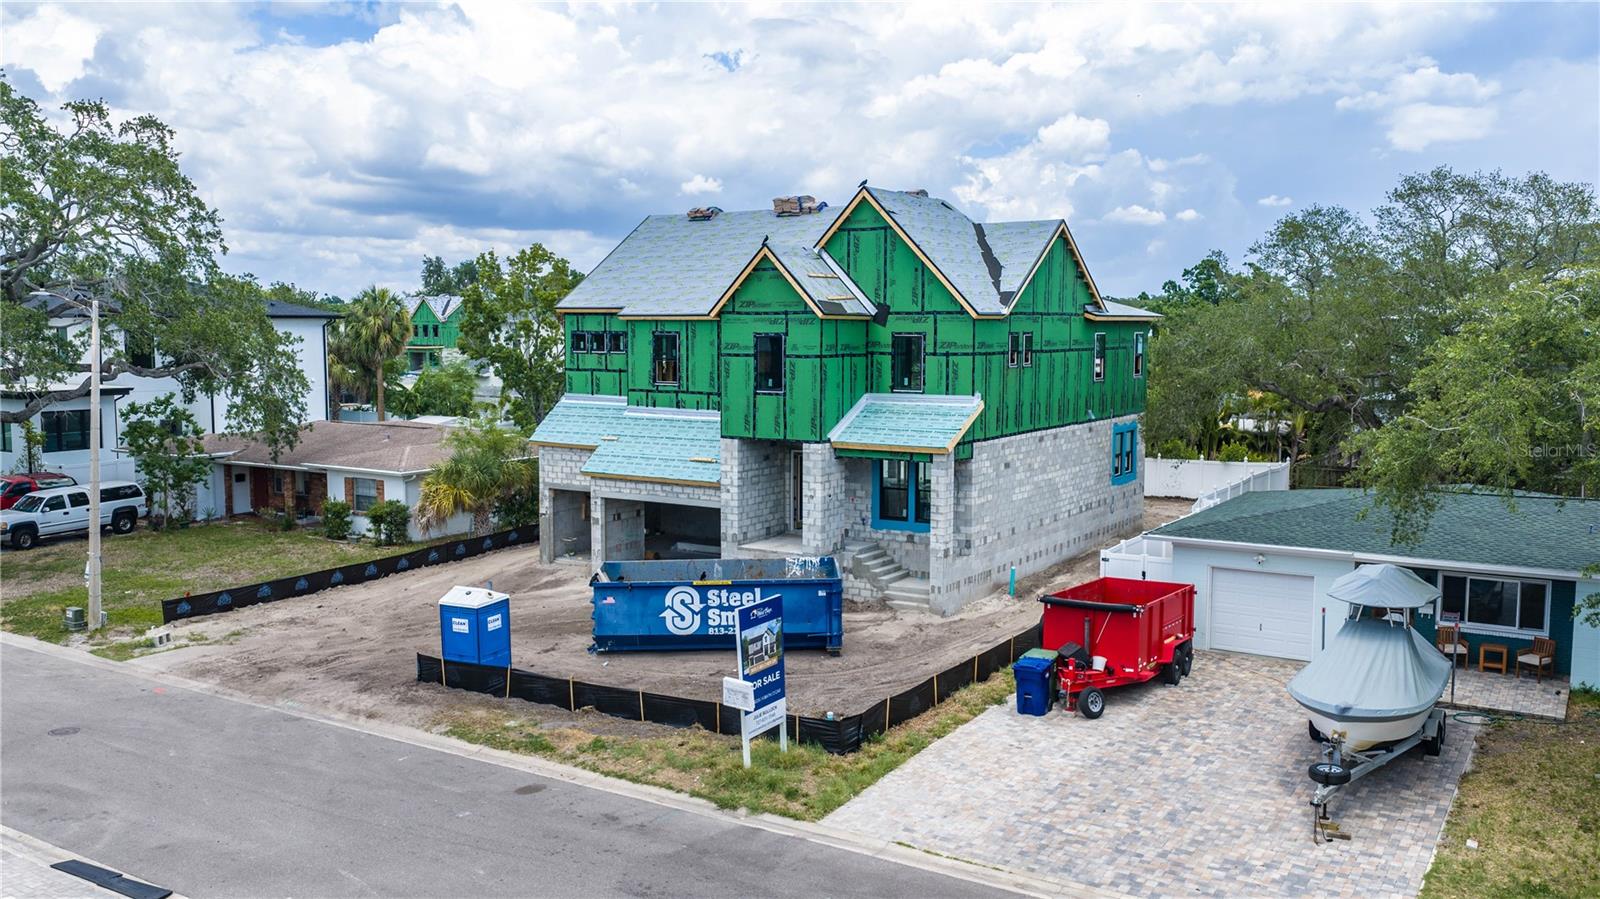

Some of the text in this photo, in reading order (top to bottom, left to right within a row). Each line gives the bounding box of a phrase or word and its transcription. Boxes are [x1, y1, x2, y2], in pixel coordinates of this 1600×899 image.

[707, 588, 761, 606] Steel
[752, 670, 781, 690] OR SALE
